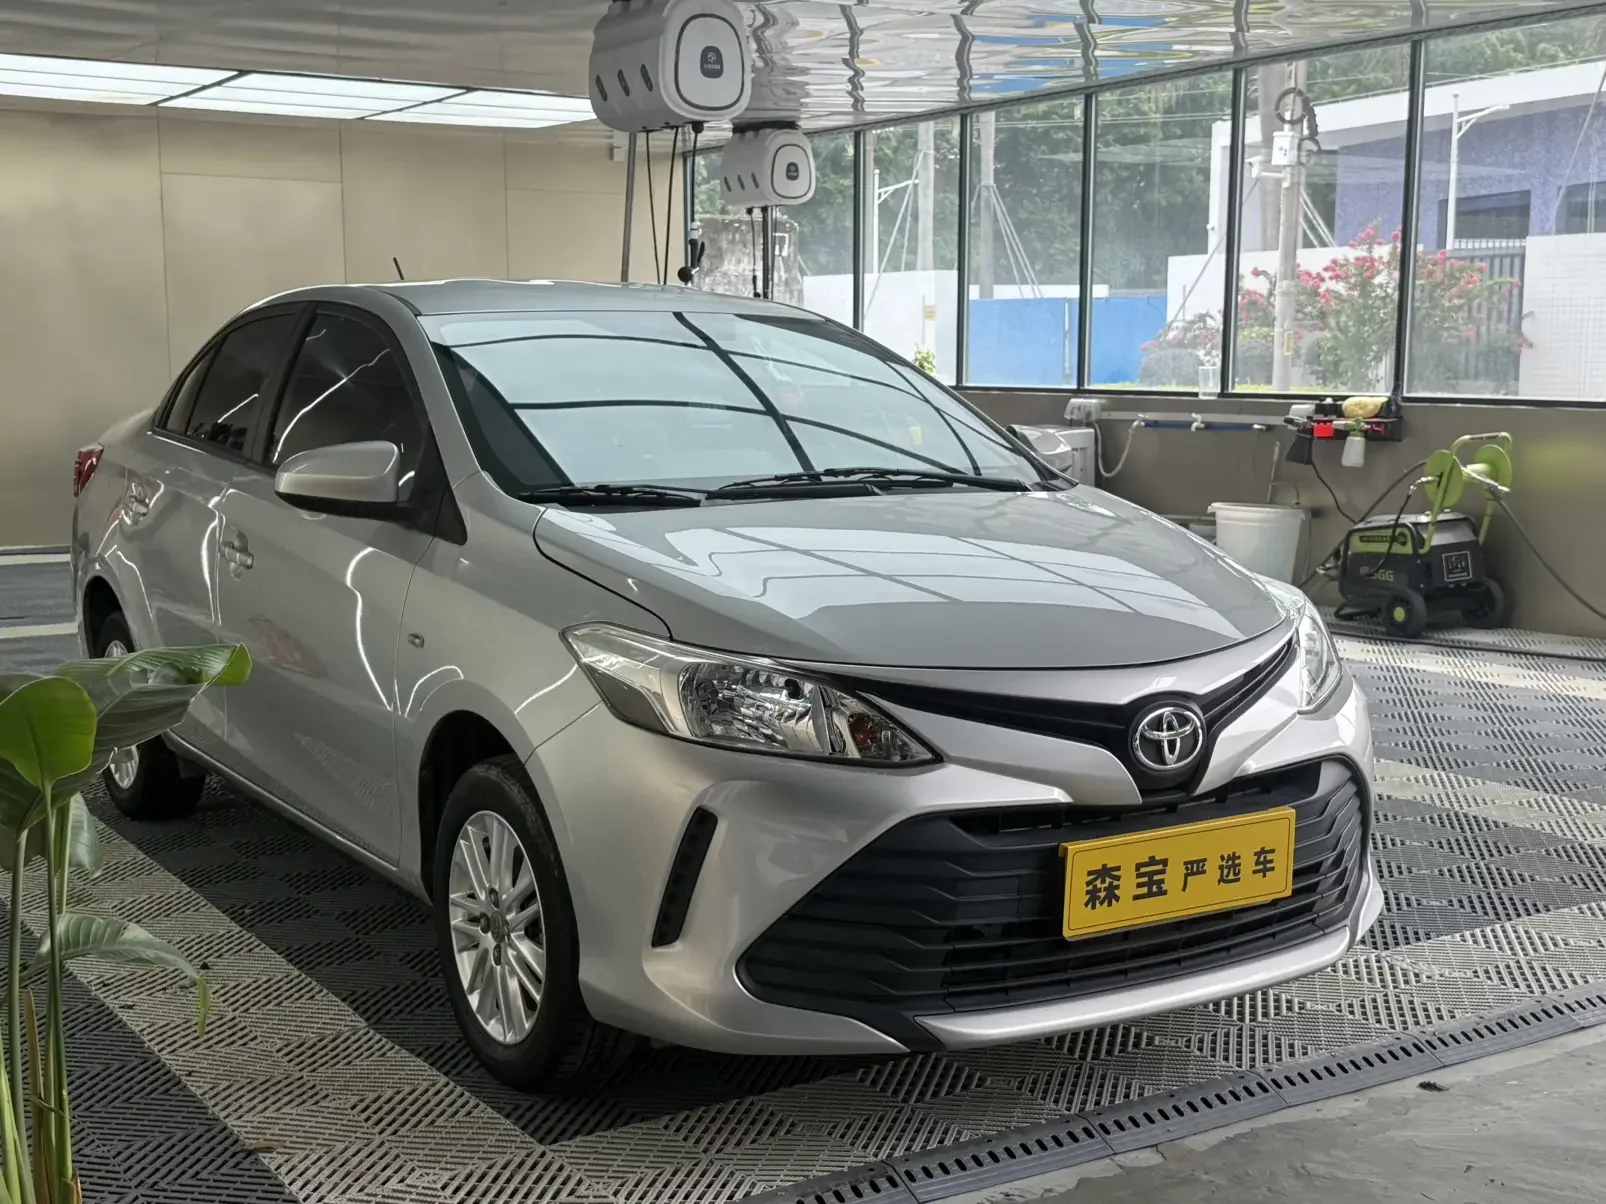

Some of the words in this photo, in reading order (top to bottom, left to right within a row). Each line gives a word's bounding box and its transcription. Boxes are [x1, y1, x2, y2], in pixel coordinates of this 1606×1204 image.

[1084, 846, 1276, 910] 森宝严选车
